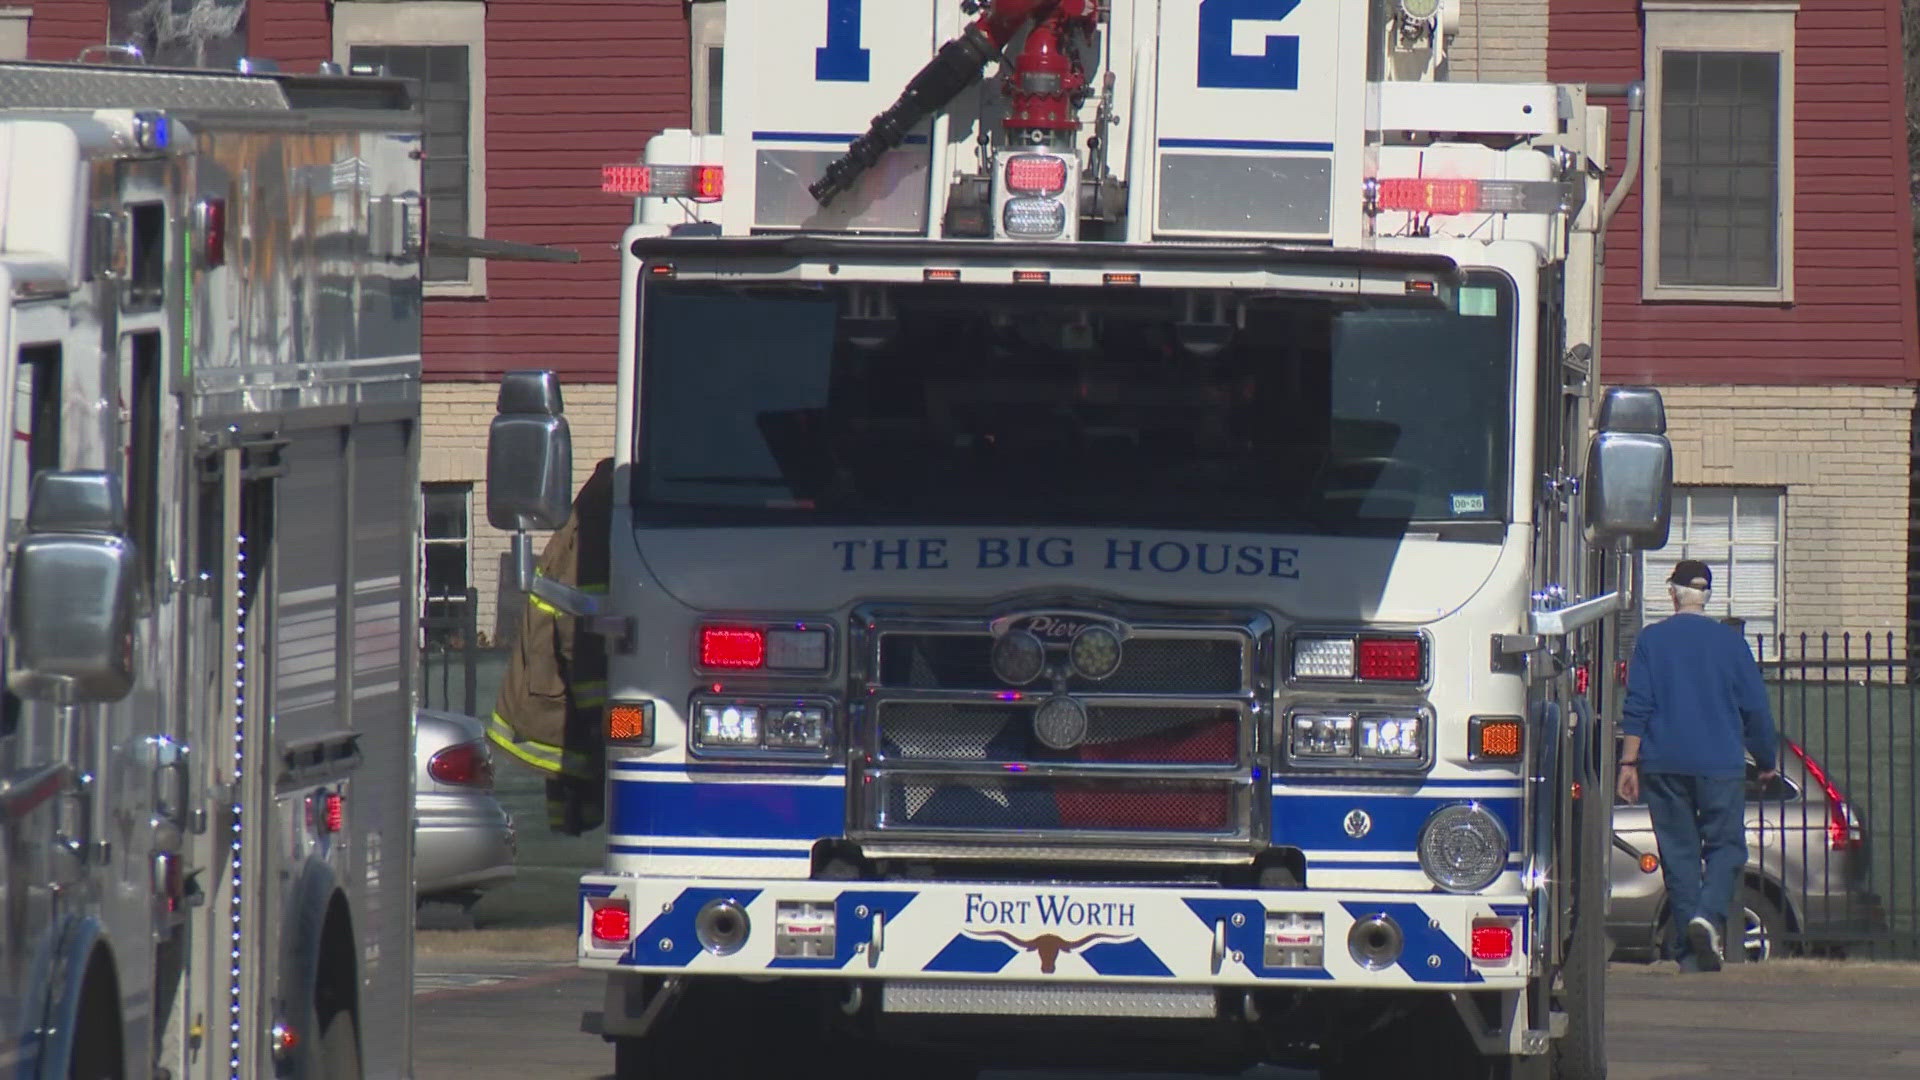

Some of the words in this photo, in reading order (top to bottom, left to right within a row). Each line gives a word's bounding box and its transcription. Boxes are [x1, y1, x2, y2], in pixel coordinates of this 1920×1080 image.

[832, 538, 949, 571] THE
[976, 536, 1074, 569] BIG
[1104, 538, 1300, 580] HOUSE
[965, 893, 1031, 924] FORT
[1035, 894, 1136, 927] WORTH
